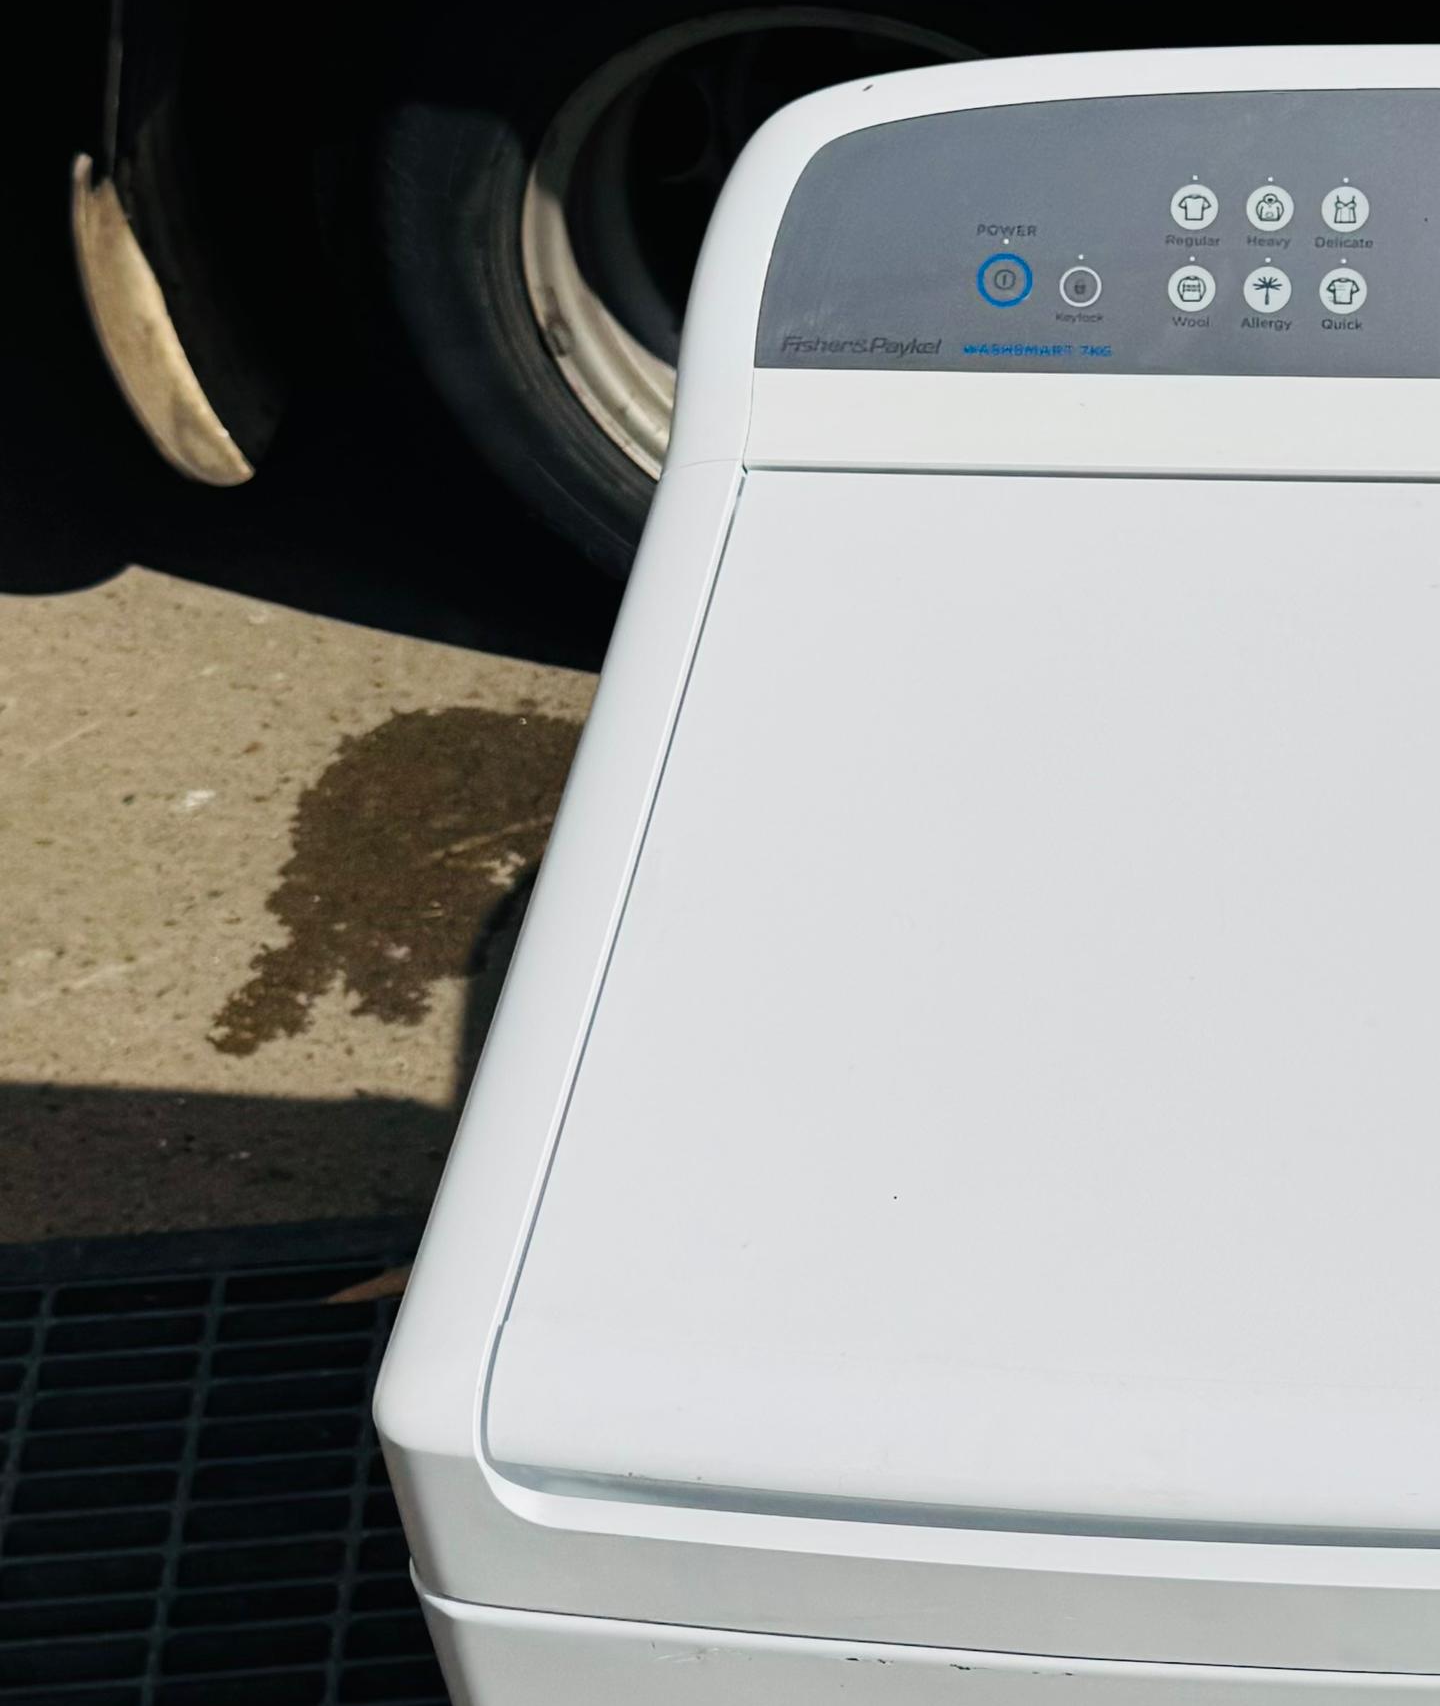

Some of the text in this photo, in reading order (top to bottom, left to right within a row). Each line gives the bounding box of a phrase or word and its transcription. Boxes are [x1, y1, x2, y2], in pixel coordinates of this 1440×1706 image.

[976, 224, 1038, 237] POWER
[1165, 235, 1220, 248] Regular
[1246, 235, 1291, 250] Heavy
[1314, 236, 1374, 249] Delicate
[1055, 312, 1104, 324] Keylock
[1172, 316, 1211, 328] Wool
[1240, 317, 1292, 332] Allergy
[1321, 318, 1364, 331] Quick
